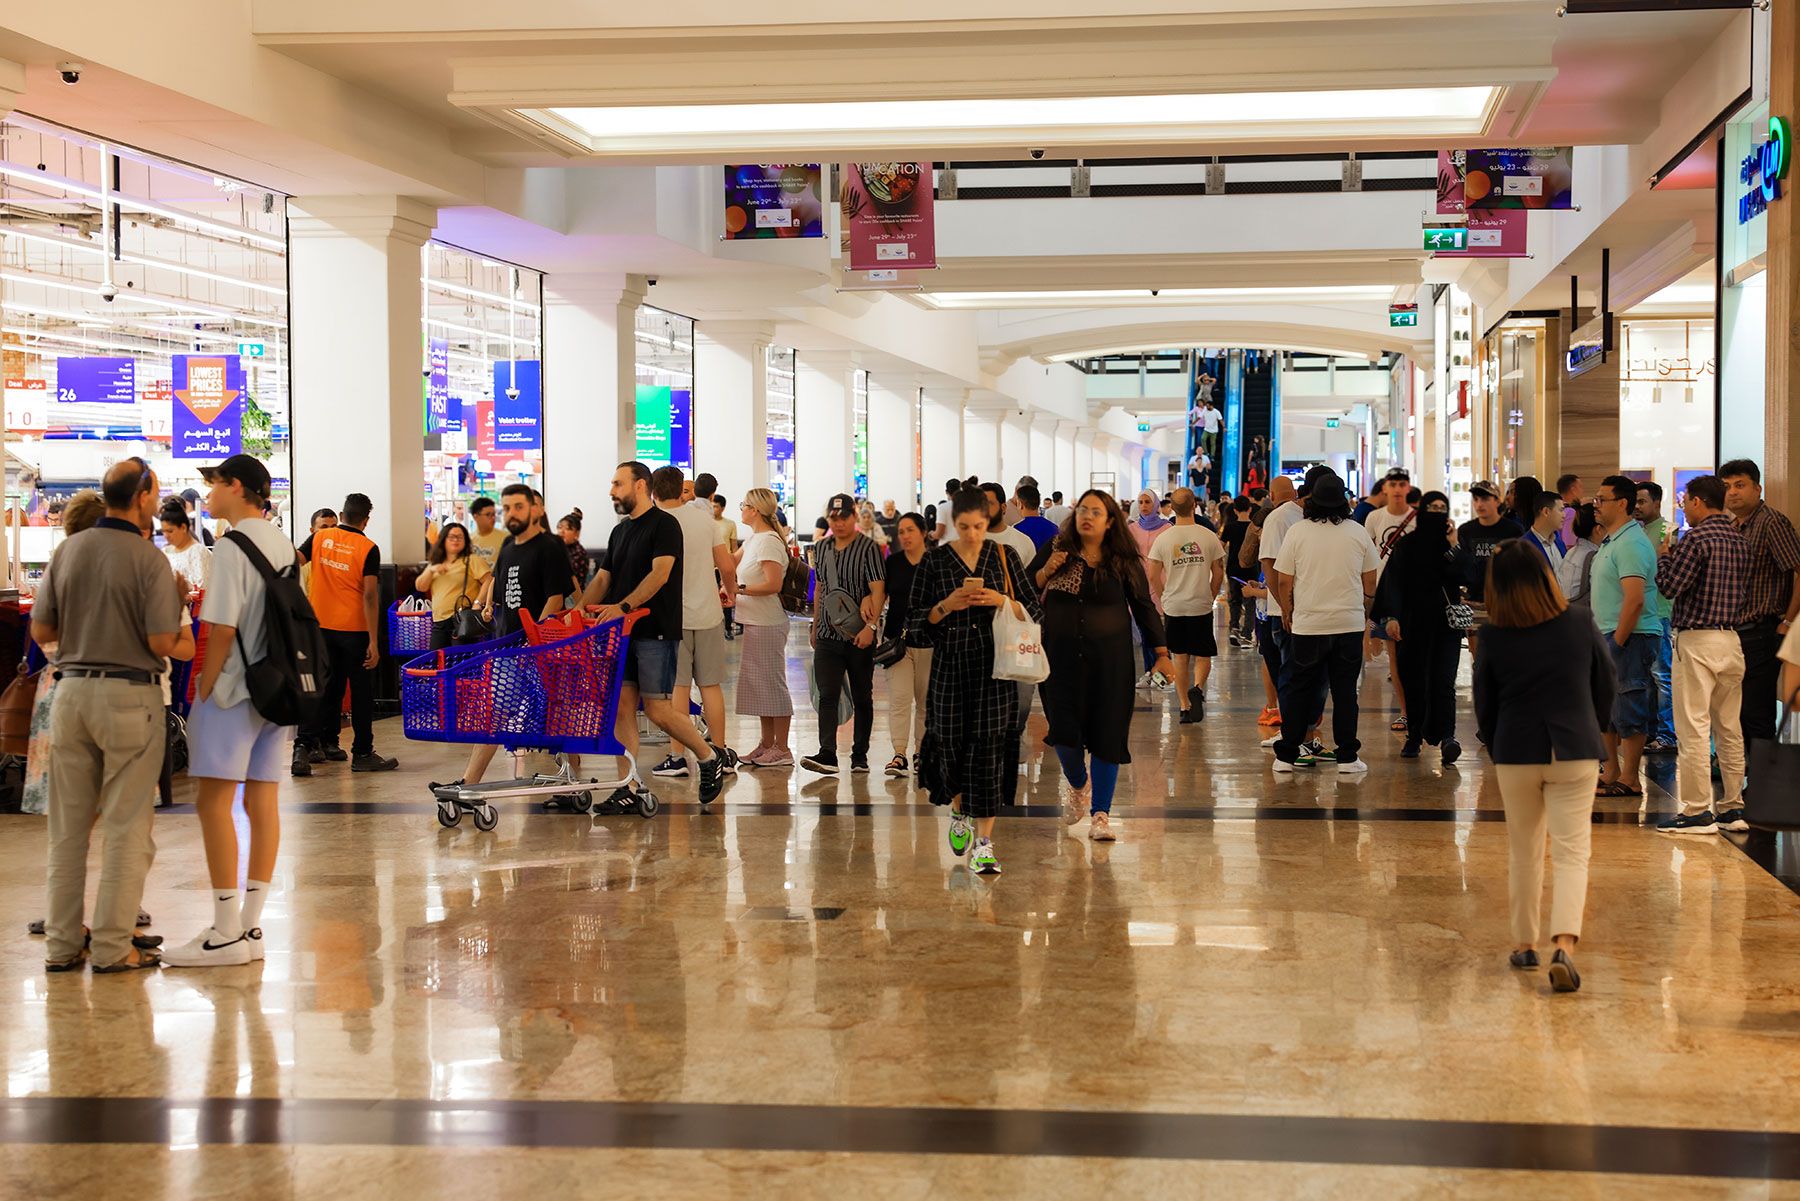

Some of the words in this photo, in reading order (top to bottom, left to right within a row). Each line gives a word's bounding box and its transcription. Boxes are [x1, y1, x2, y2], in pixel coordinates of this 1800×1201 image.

[190, 366, 223, 378] LOWEST
[8, 380, 23, 388] Deal
[190, 379, 223, 392] PRICES
[59, 388, 77, 401] 26
[431, 395, 447, 414] FAST
[183, 428, 213, 439] السهم
[214, 428, 231, 439] اتبع
[183, 442, 210, 453] الكثير
[1172, 556, 1205, 566] LOURES
